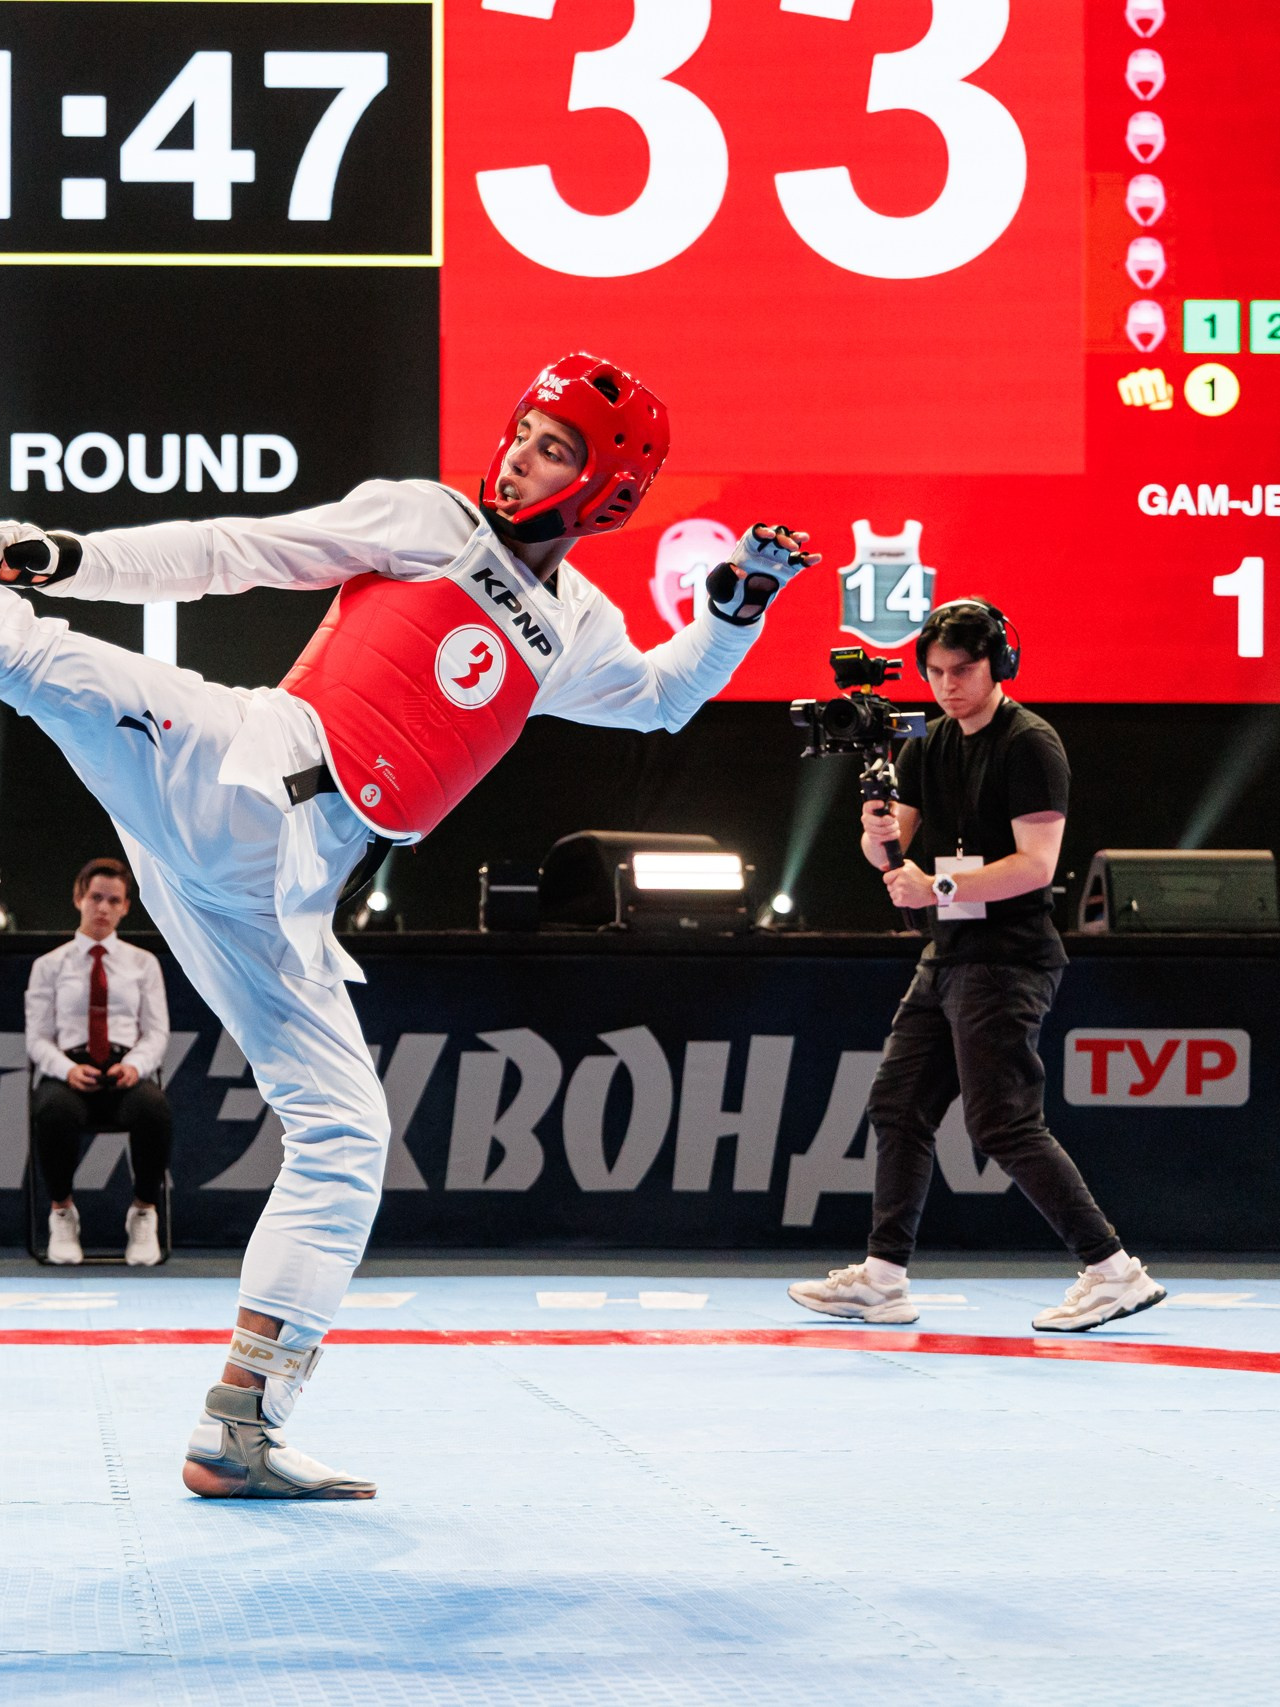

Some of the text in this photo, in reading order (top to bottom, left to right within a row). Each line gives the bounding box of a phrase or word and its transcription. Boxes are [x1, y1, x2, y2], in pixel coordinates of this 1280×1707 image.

[475, 0, 1027, 279] 33
[1204, 314, 1216, 339] 1
[1204, 378, 1215, 401] 1
[10, 432, 298, 493] ROUND
[471, 568, 552, 656] KPNP
[846, 563, 931, 623] 14
[1213, 556, 1264, 658] 1
[365, 788, 377, 803] 3
[1075, 1039, 1237, 1095] ТУР
